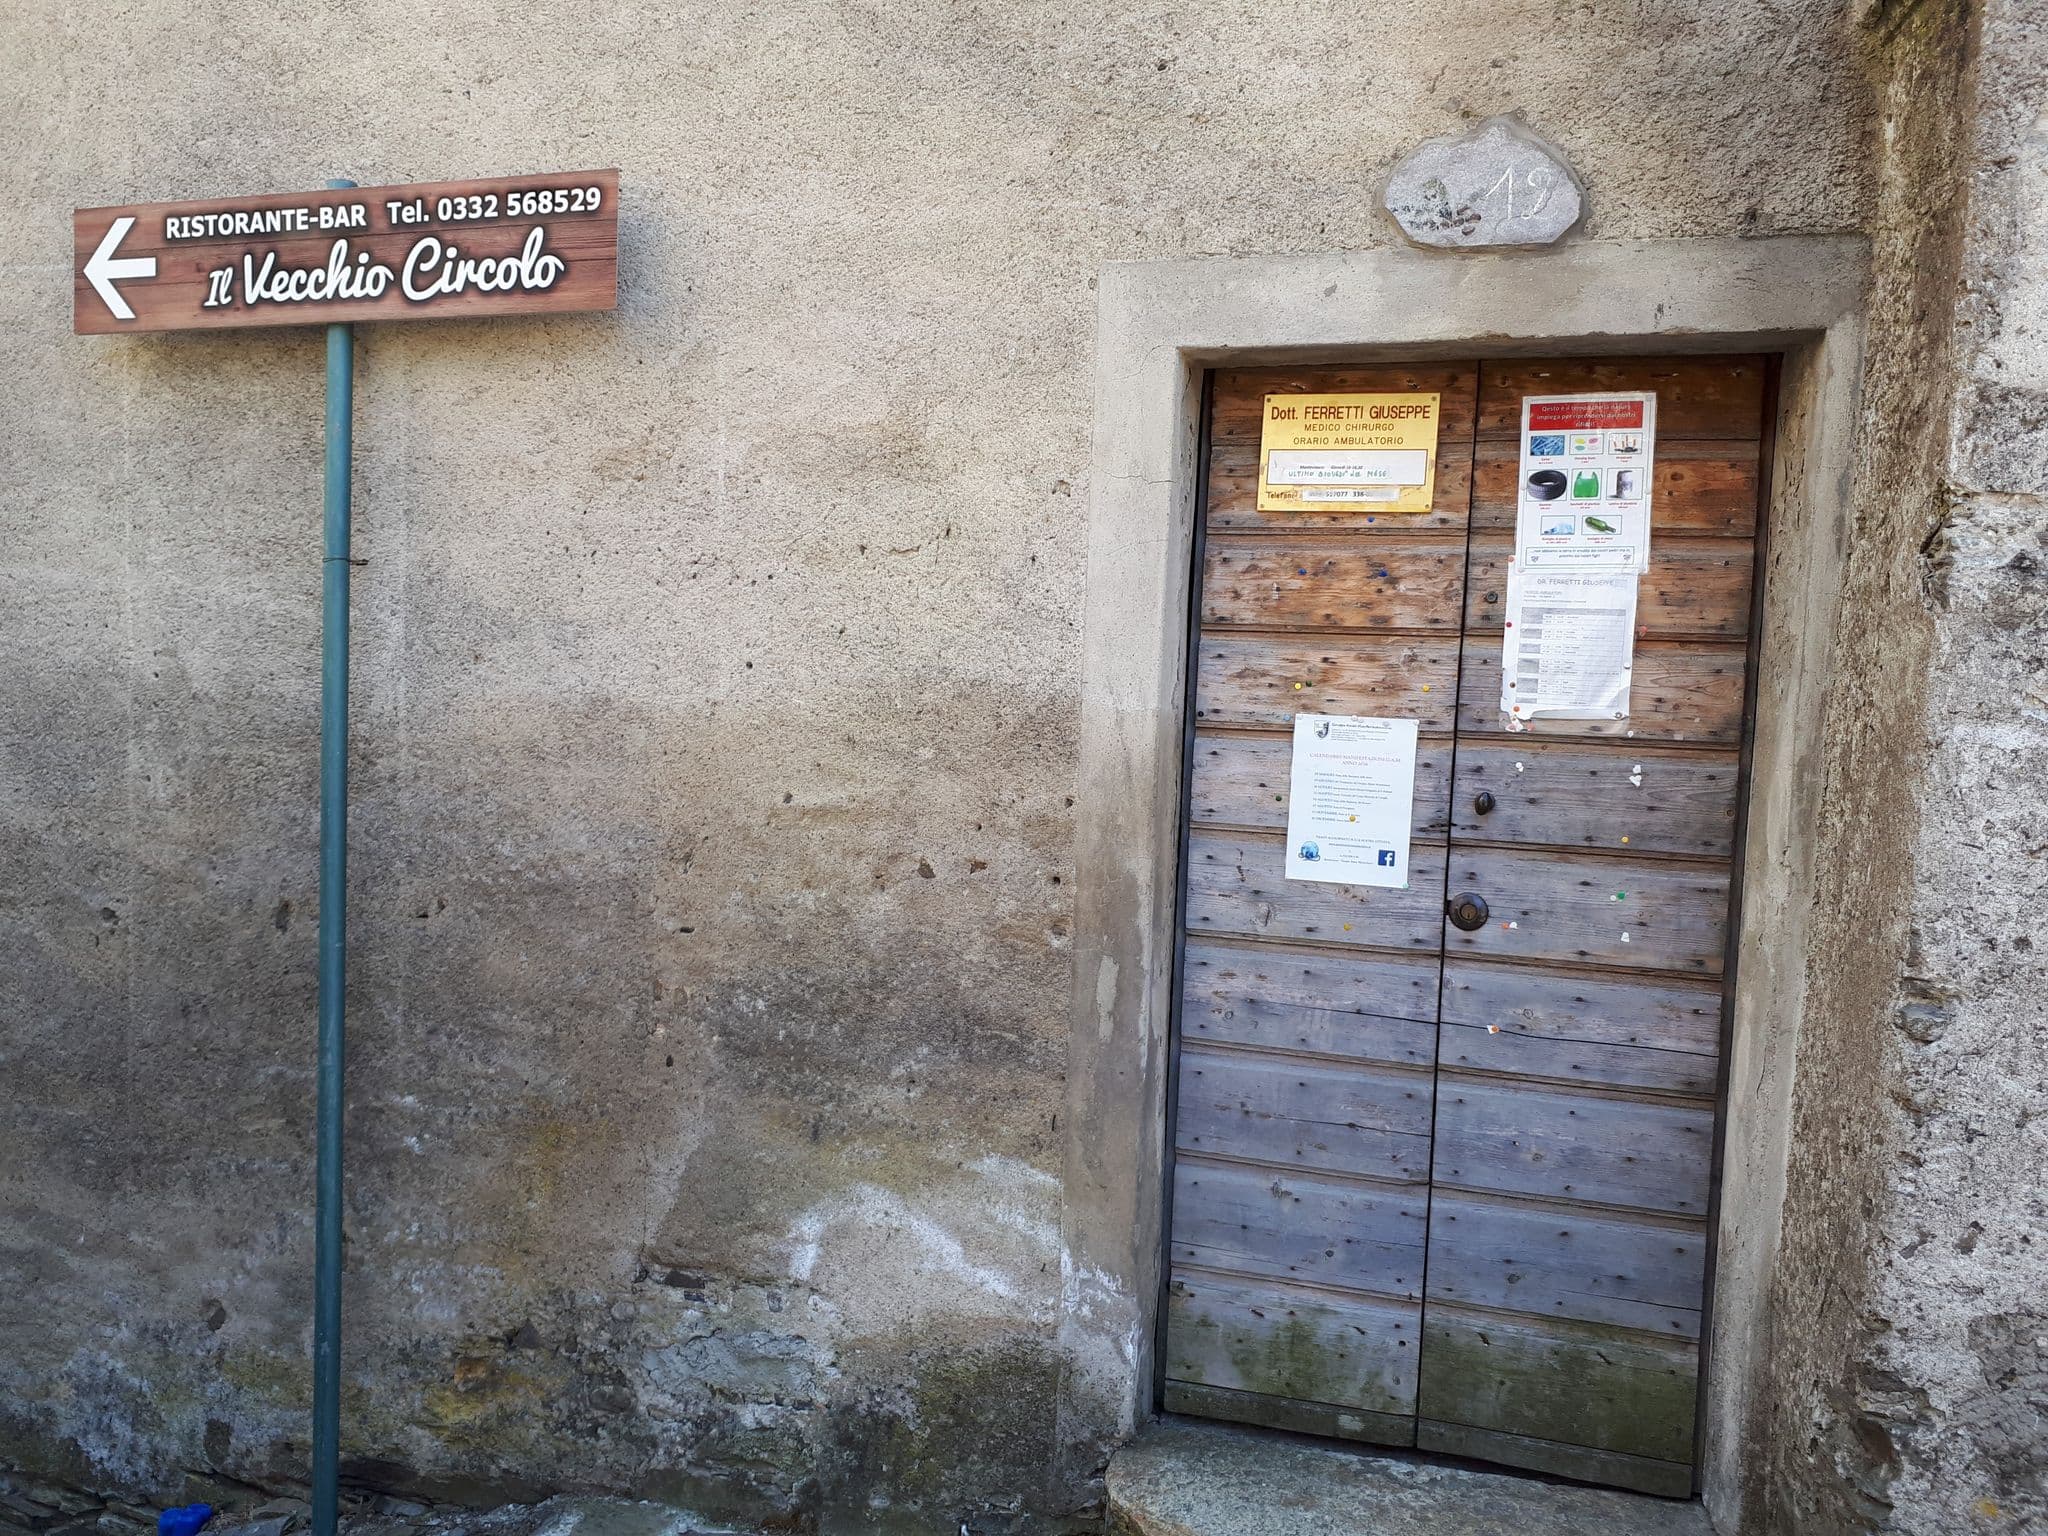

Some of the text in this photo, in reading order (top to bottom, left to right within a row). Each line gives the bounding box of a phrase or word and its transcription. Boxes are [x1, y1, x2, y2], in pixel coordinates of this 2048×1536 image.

[166, 187, 601, 240] RISTORANTE-BAR Tel. 0332 568529
[203, 226, 565, 307] Il Vecchio Circolo
[1271, 404, 1431, 420] Dott. FERRETTI GIUSEPPE
[1304, 423, 1395, 432] MEDICO CHIRURGO
[1293, 436, 1404, 445] ORARIO AMBULATORIO
